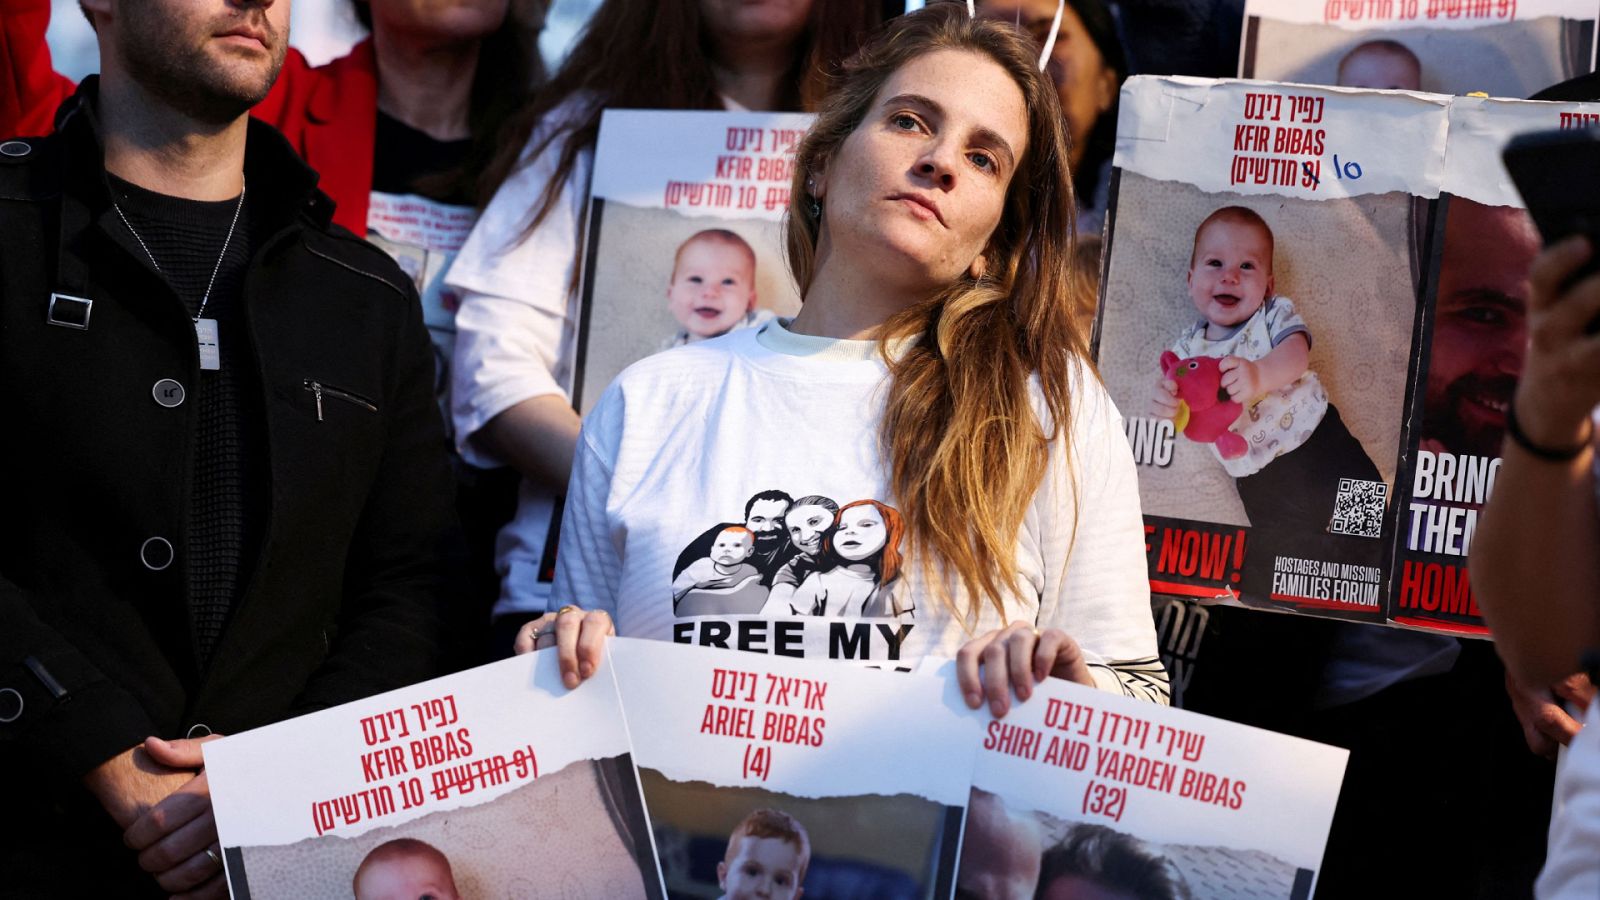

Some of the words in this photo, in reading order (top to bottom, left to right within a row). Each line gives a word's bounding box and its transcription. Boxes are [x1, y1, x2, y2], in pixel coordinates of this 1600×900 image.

[1244, 93, 1282, 120] ביבס
[1288, 96, 1325, 123] כפיר
[726, 127, 763, 152] ביבס
[1233, 124, 1270, 152] KFIR
[1273, 127, 1326, 156] BIBAS
[715, 155, 752, 180] KFIR
[1231, 154, 1298, 187] חודשים)
[1333, 154, 1363, 180] 10
[736, 186, 758, 209] 10
[1121, 416, 1176, 467] ING
[1157, 527, 1246, 583] NOW!
[1274, 556, 1320, 577] HOSTAGES
[1320, 561, 1340, 579] AND
[1341, 563, 1381, 583] MISSING
[1272, 572, 1331, 600] FAMILIES
[1333, 579, 1380, 607] FORUM
[673, 620, 805, 659] FREE
[828, 622, 915, 660] MY
[711, 668, 758, 702] ביבס
[765, 672, 827, 711] אריאל
[360, 709, 410, 746] ביבס
[411, 695, 458, 733] כפיר
[700, 704, 756, 740] ARIEL
[762, 710, 826, 748] BIBAS
[1043, 697, 1094, 737] ביבס
[1097, 711, 1151, 750] וירדן
[361, 745, 408, 783] KFIR
[410, 728, 472, 770] BIBAS
[1156, 724, 1205, 763] שירי
[743, 744, 772, 782] (4)
[983, 720, 1042, 761] SHIRI
[1043, 735, 1090, 772] AND
[1095, 746, 1177, 794] YARDEN
[1178, 768, 1247, 811] BIBAS
[312, 785, 396, 836] חודשים)
[398, 777, 425, 810] 10
[1081, 780, 1127, 822] (32)
